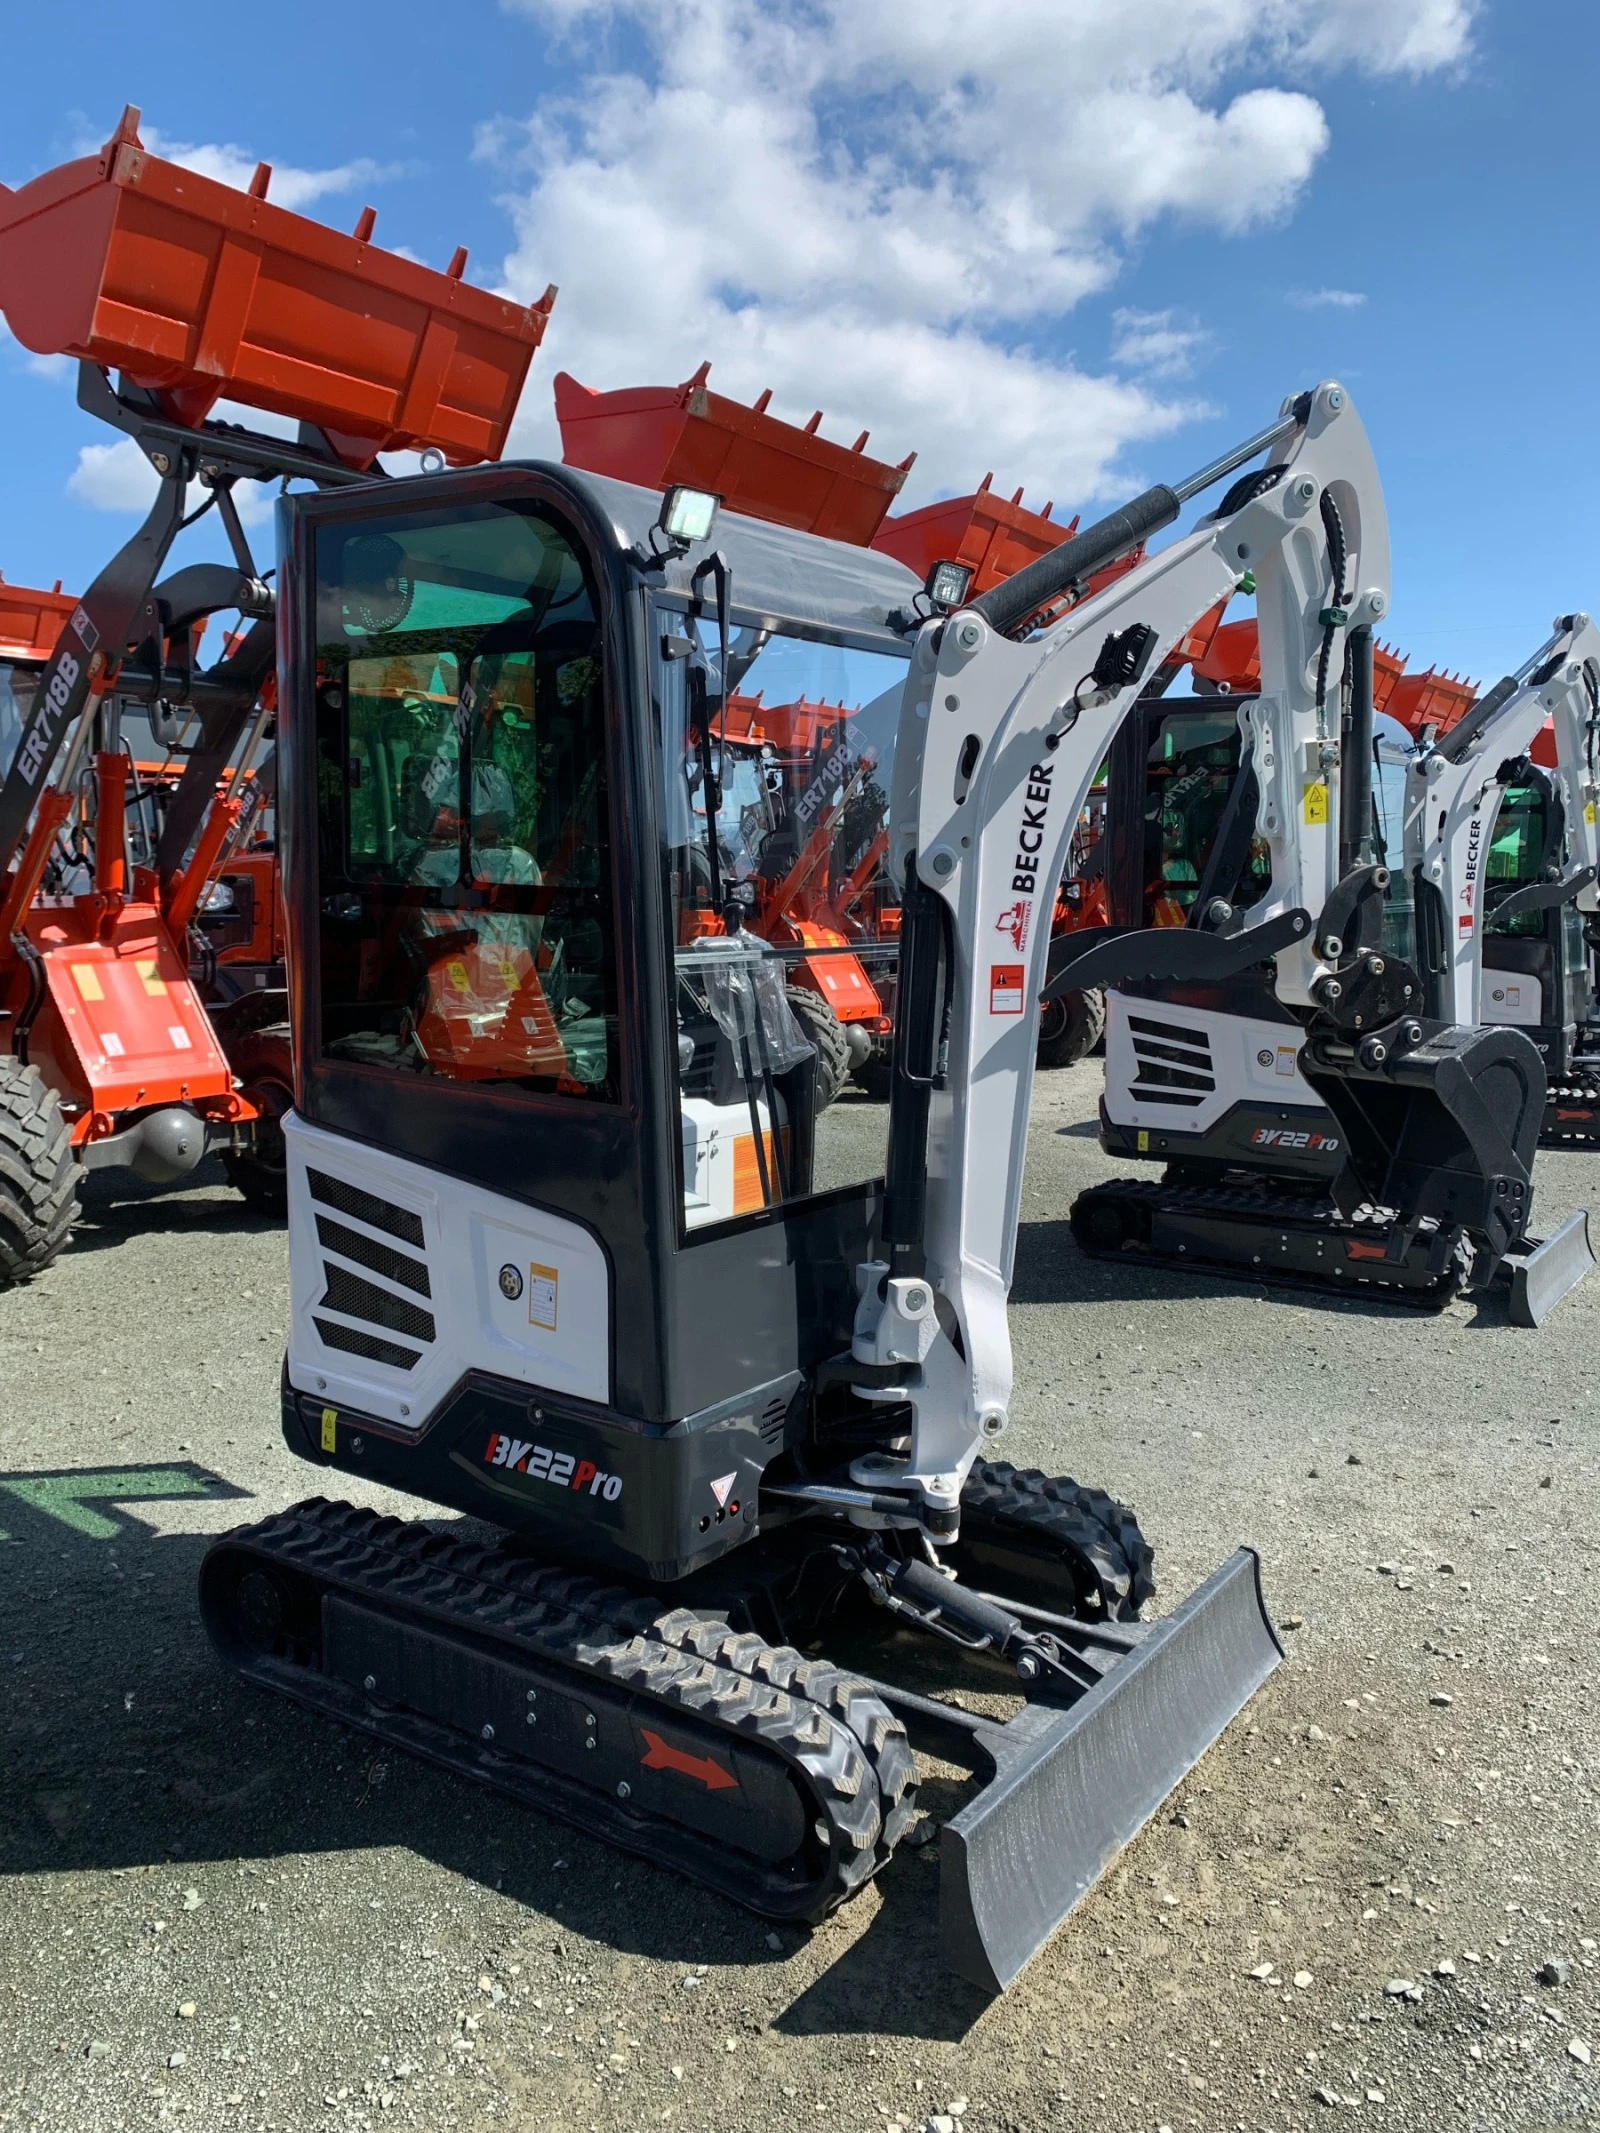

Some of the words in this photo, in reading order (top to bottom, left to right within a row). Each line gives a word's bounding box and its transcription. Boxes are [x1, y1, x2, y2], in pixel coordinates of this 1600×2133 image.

[17, 651, 80, 786] ER718B
[793, 743, 853, 823] ER718B
[1011, 763, 1054, 894] BECKER
[1465, 819, 1481, 880] BECKER
[1019, 900, 1033, 953] MASCHINEN
